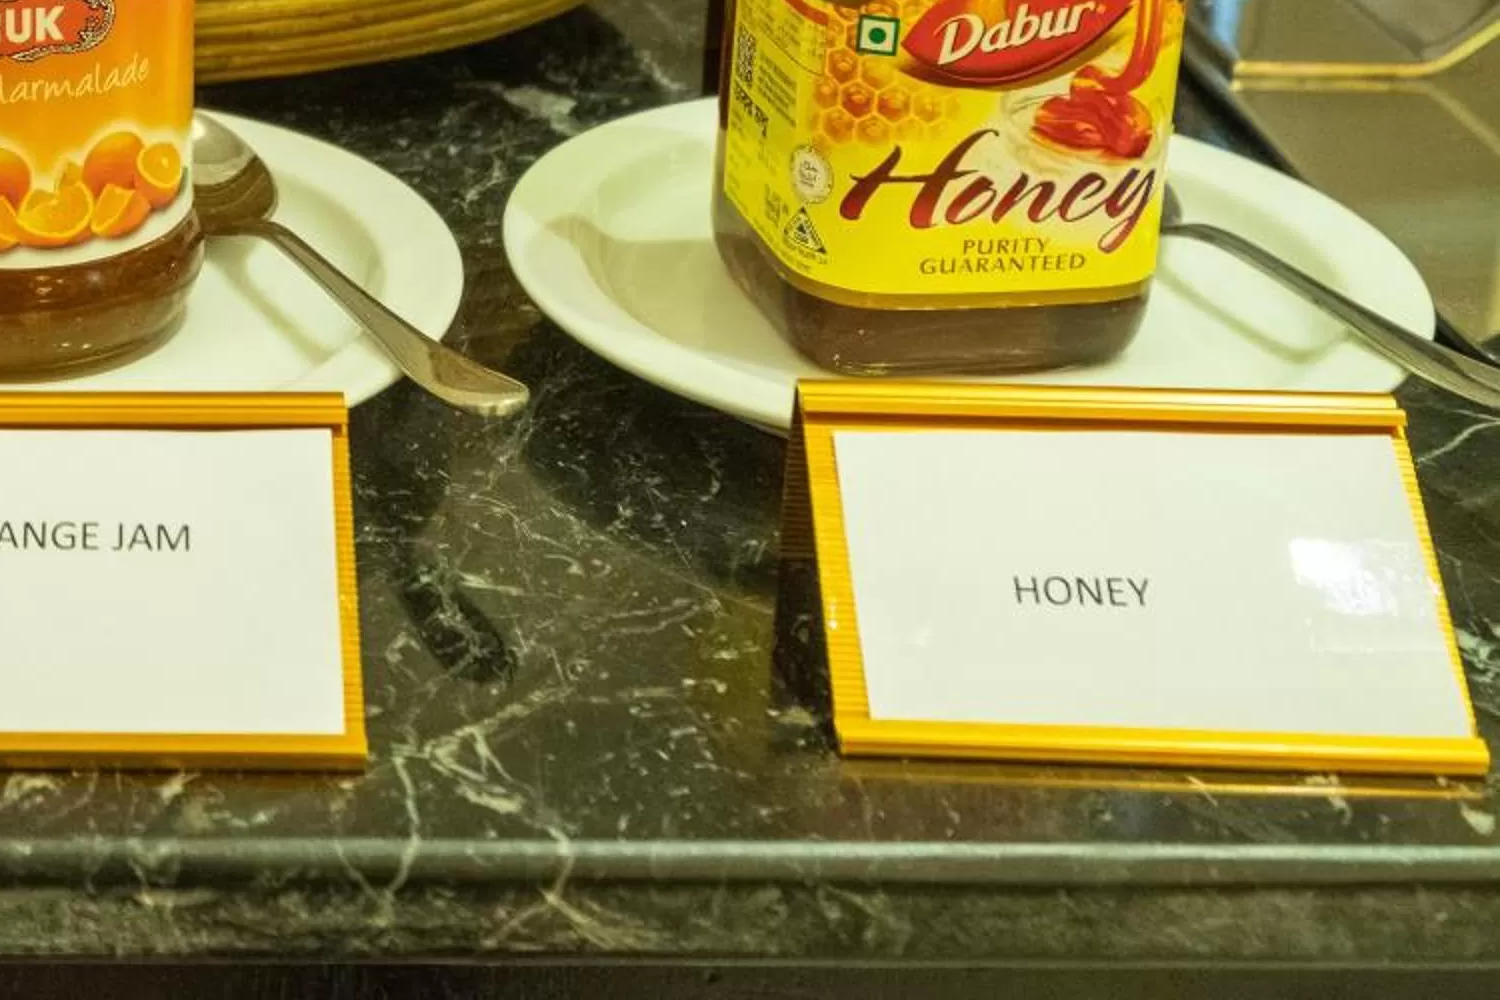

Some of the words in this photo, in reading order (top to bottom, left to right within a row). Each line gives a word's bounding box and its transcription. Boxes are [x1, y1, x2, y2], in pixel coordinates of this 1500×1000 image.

[838, 128, 1157, 254] Honey
[962, 236, 1051, 256] PURITY
[919, 252, 1086, 276] GUARANTEED
[111, 521, 191, 552] JAM
[1012, 574, 1149, 607] HONEY
